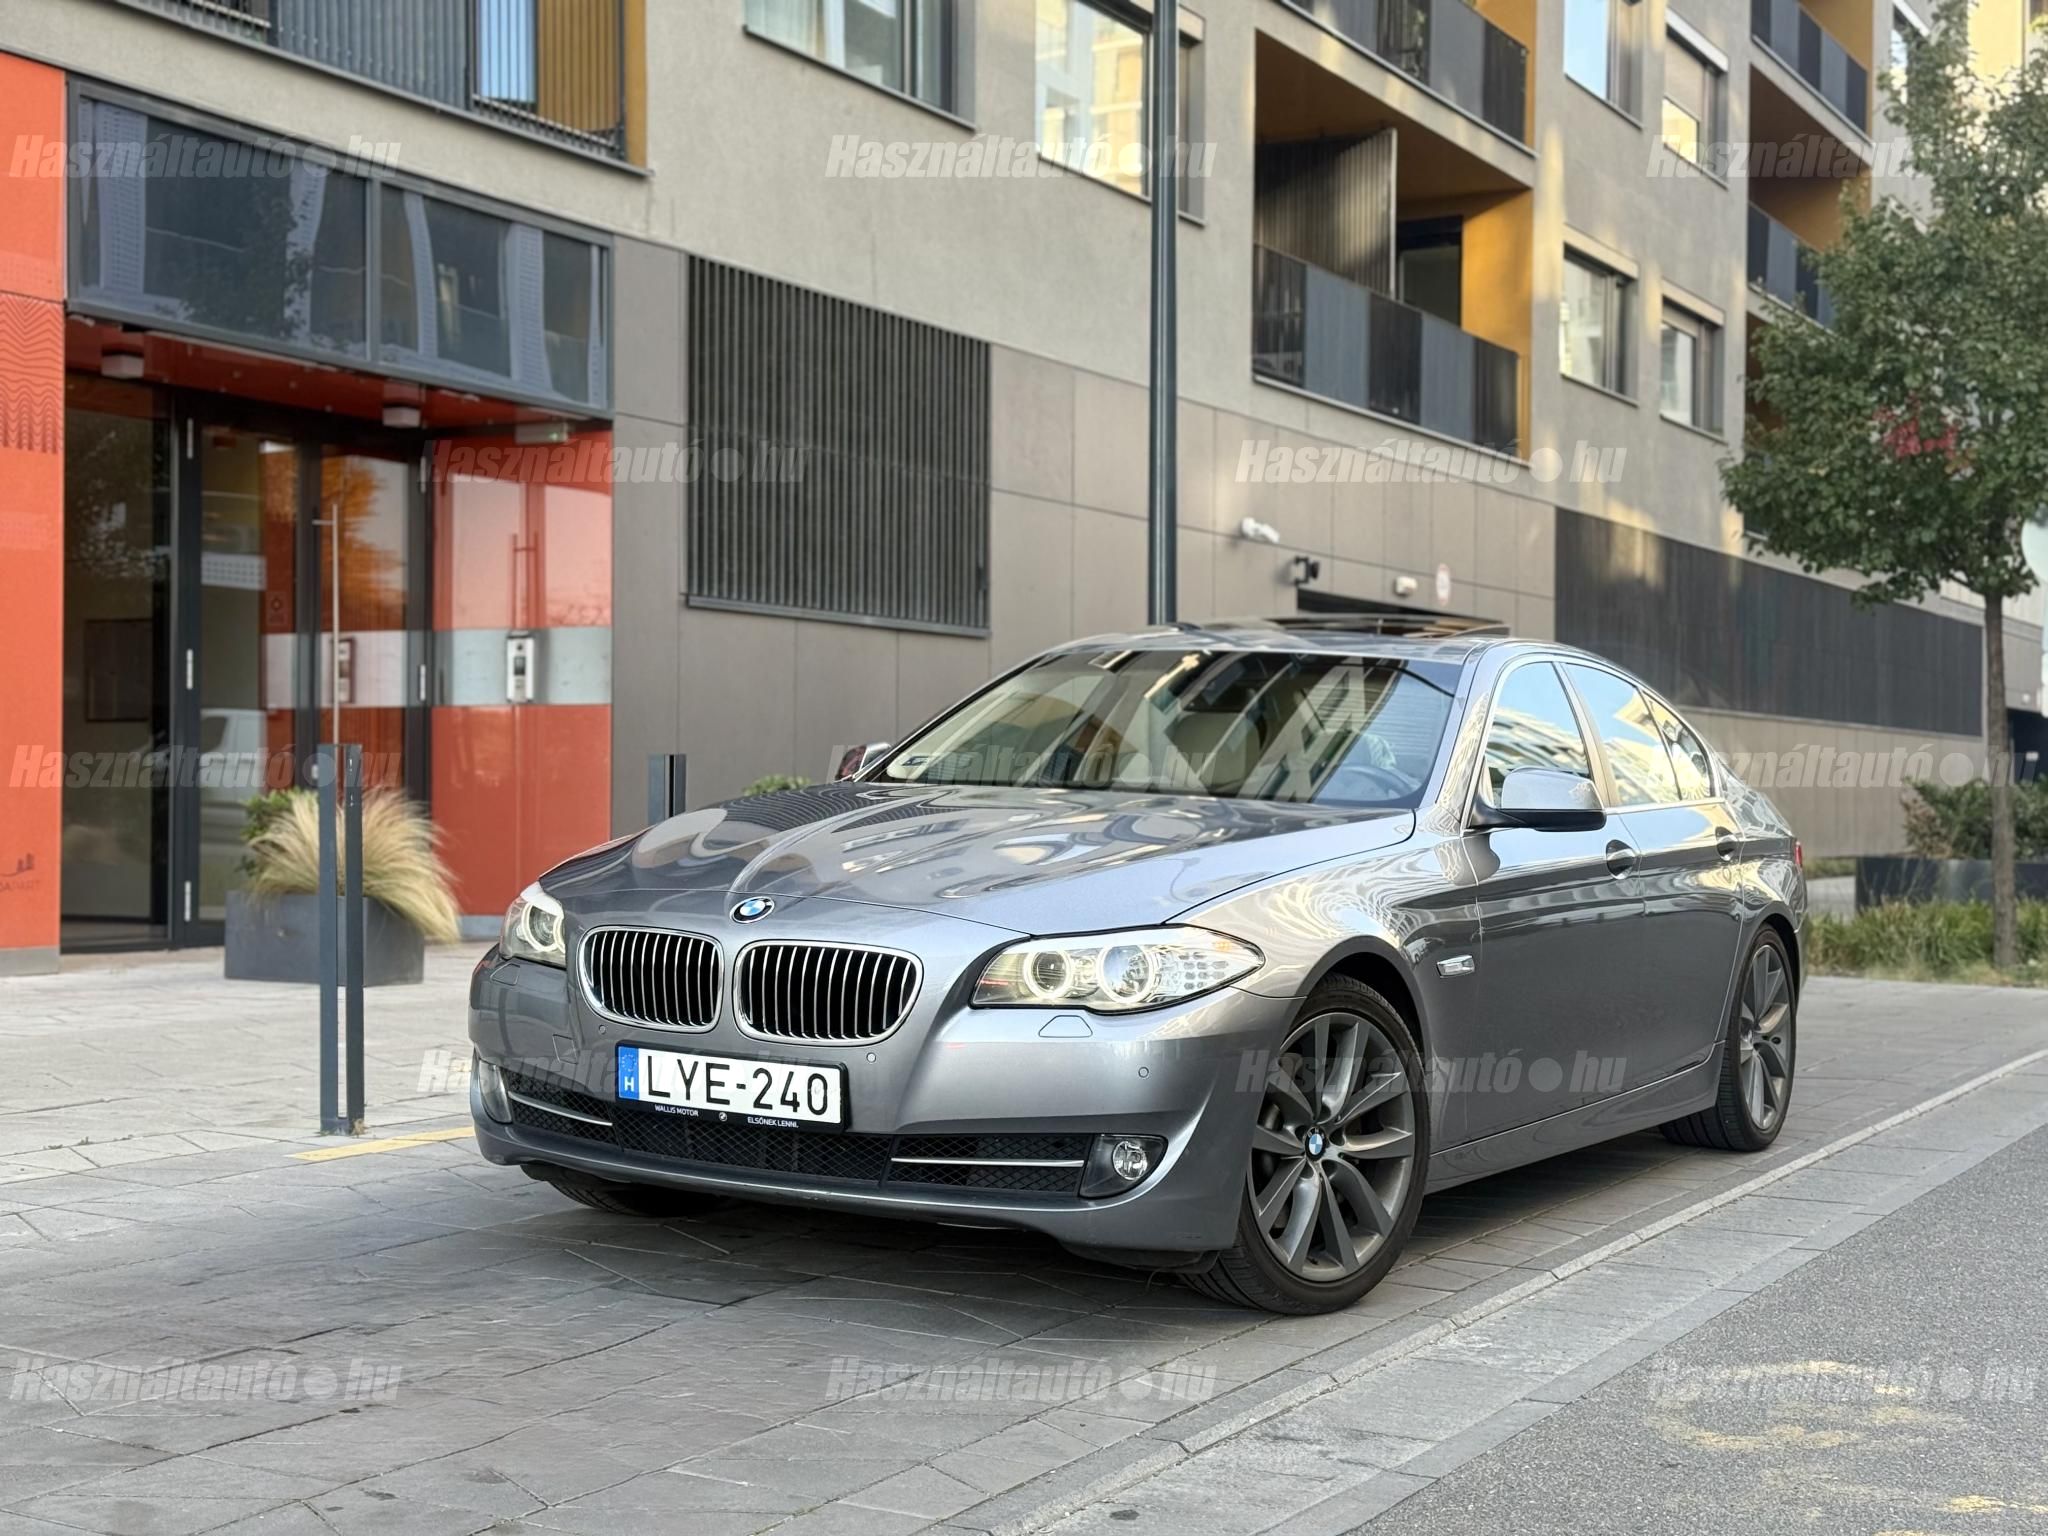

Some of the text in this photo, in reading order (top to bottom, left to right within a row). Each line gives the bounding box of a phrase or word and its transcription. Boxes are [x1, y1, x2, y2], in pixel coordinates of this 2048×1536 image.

[624, 1076, 635, 1092] H
[648, 1055, 828, 1116] LYE-240
[654, 1104, 699, 1117] WALLIS MOTOR
